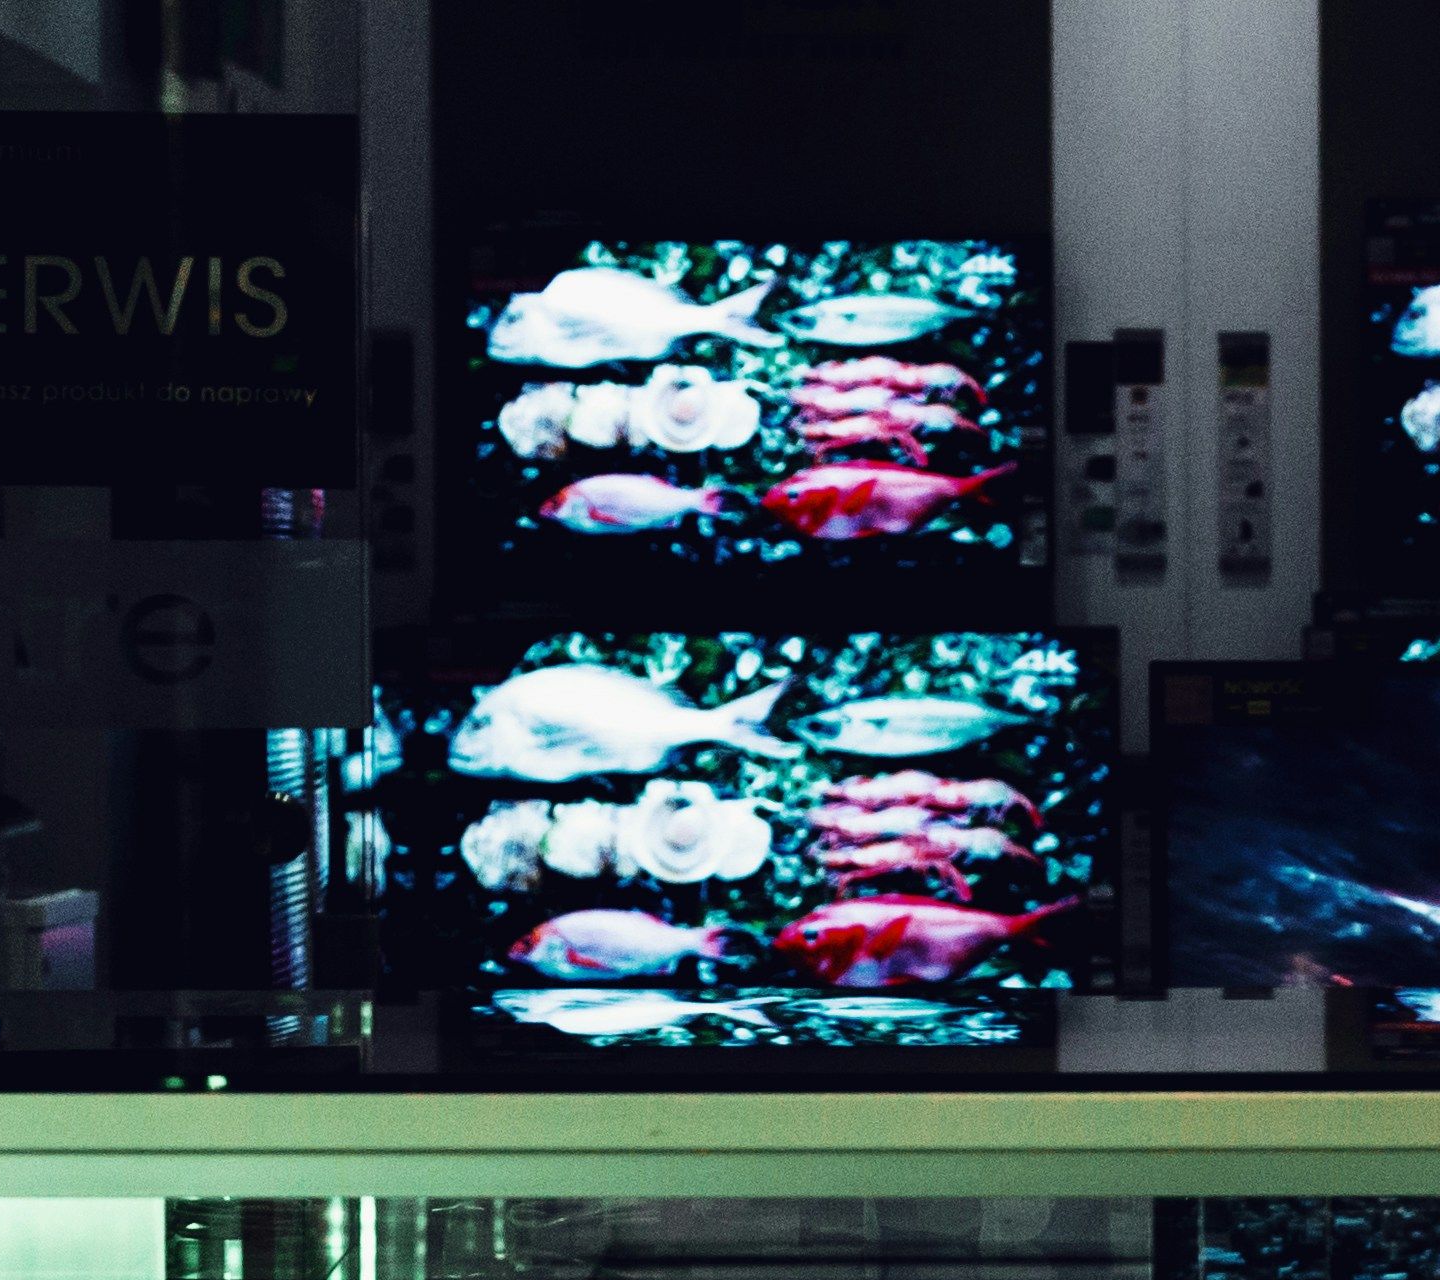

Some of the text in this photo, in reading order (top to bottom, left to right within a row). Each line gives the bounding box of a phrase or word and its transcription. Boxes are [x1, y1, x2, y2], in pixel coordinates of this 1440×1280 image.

[42, 377, 145, 405] produkt
[158, 378, 191, 402] do
[200, 383, 318, 408] naprawy
